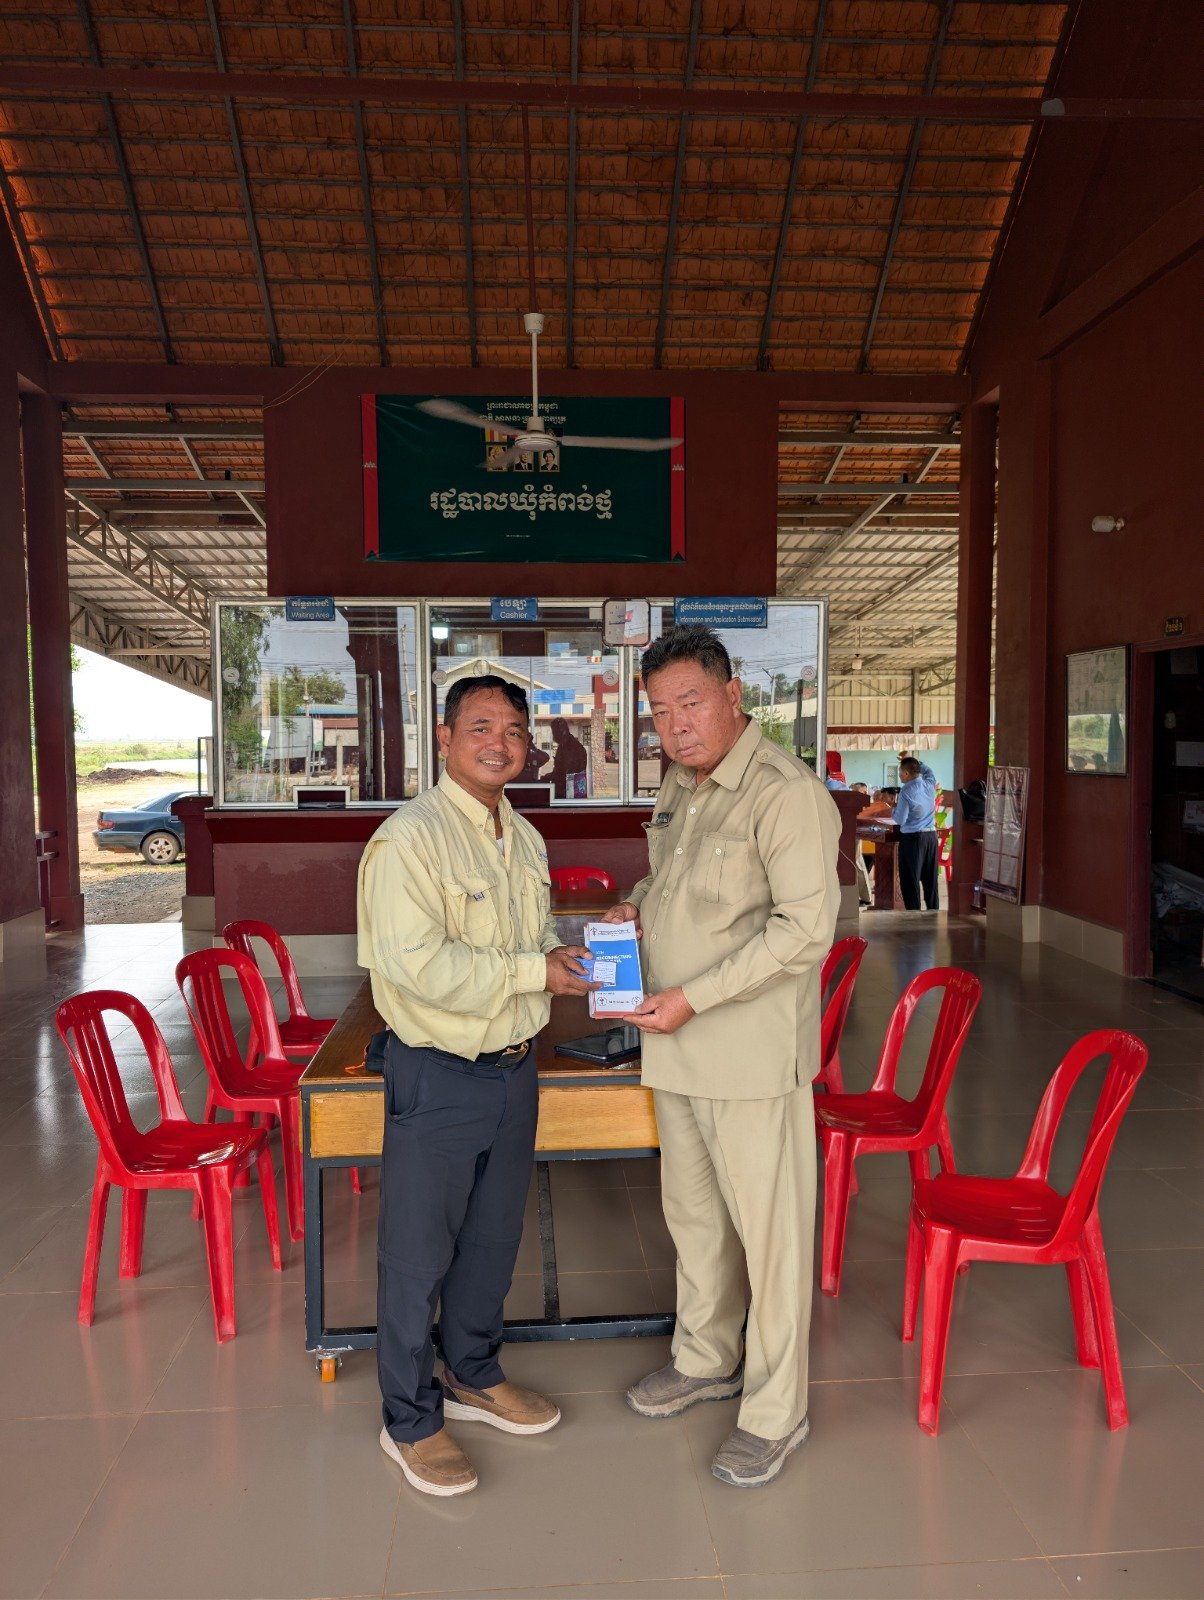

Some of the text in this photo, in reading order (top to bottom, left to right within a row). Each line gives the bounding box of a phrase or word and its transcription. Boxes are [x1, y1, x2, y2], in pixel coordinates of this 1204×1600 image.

[291, 611, 330, 620] Waiting Area
[499, 611, 528, 619] Cashier
[712, 615, 737, 624] Application
